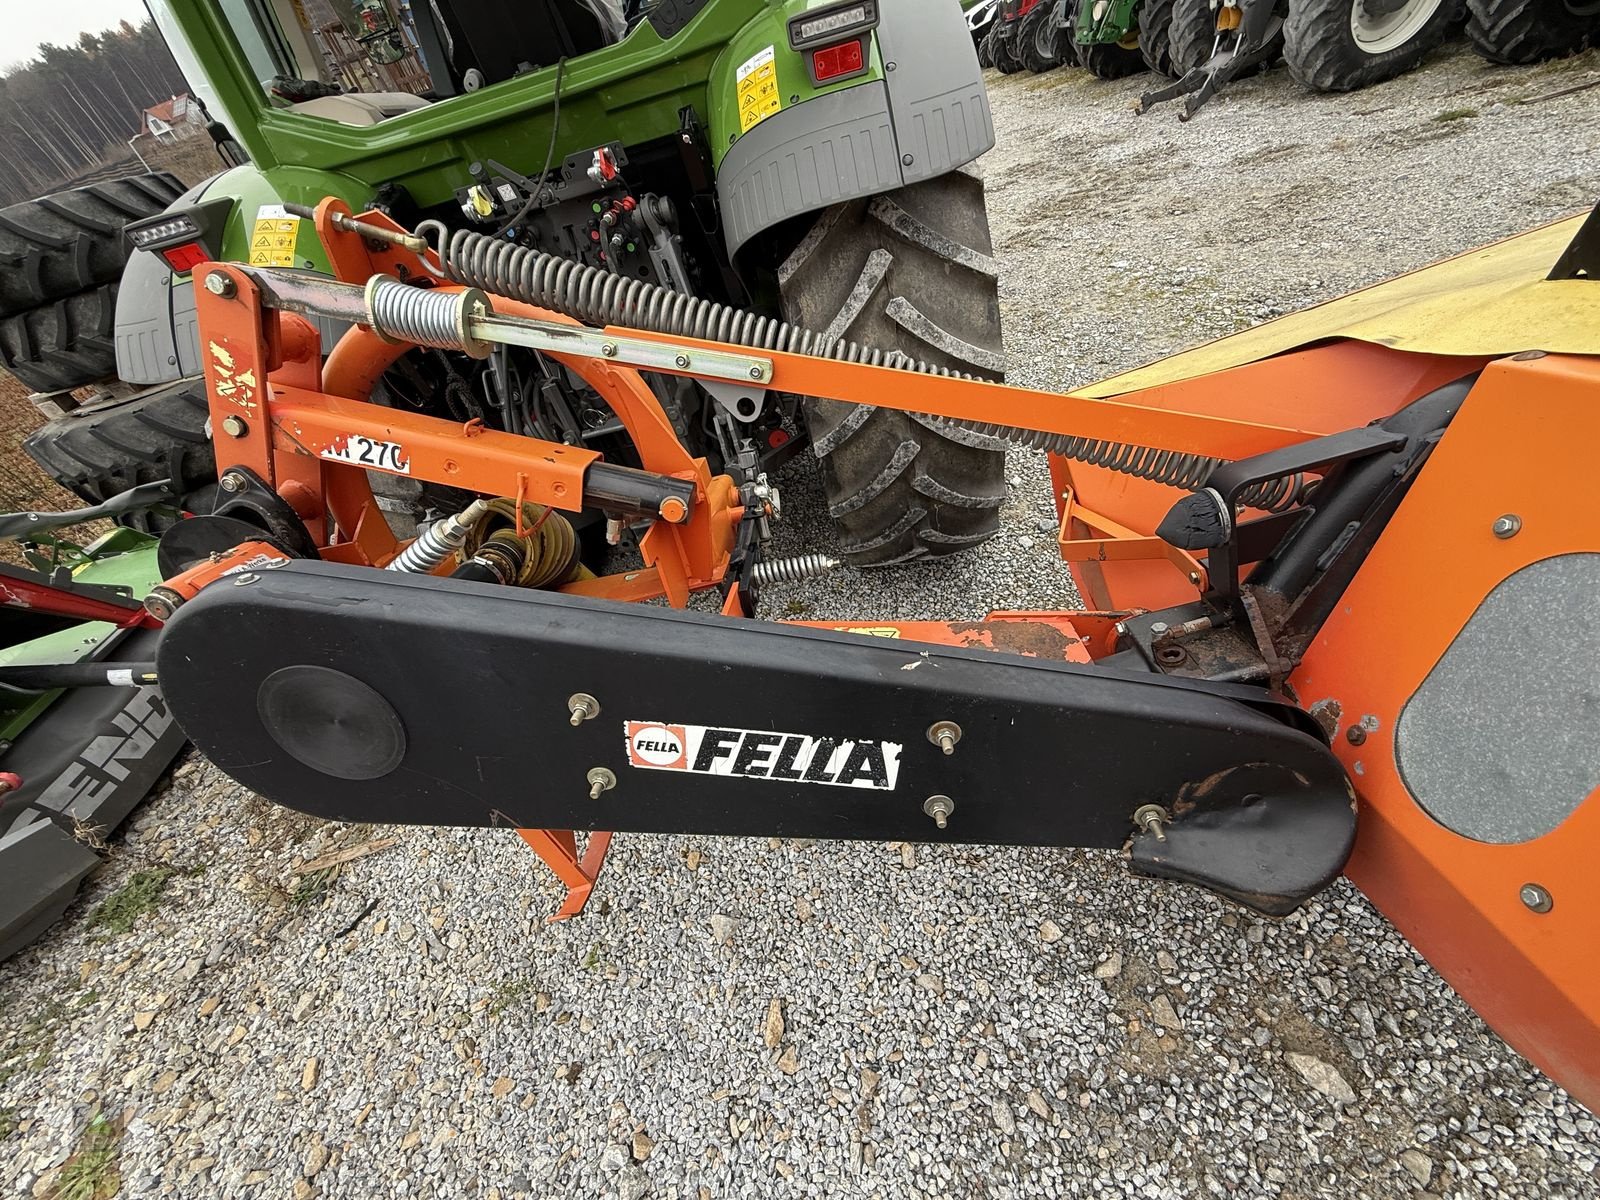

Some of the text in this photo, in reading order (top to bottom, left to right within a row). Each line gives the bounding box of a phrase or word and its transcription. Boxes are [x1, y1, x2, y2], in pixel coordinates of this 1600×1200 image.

[357, 437, 406, 470] 270
[3, 684, 174, 839] END
[636, 739, 680, 754] FELLA
[692, 728, 890, 788] FELLA
